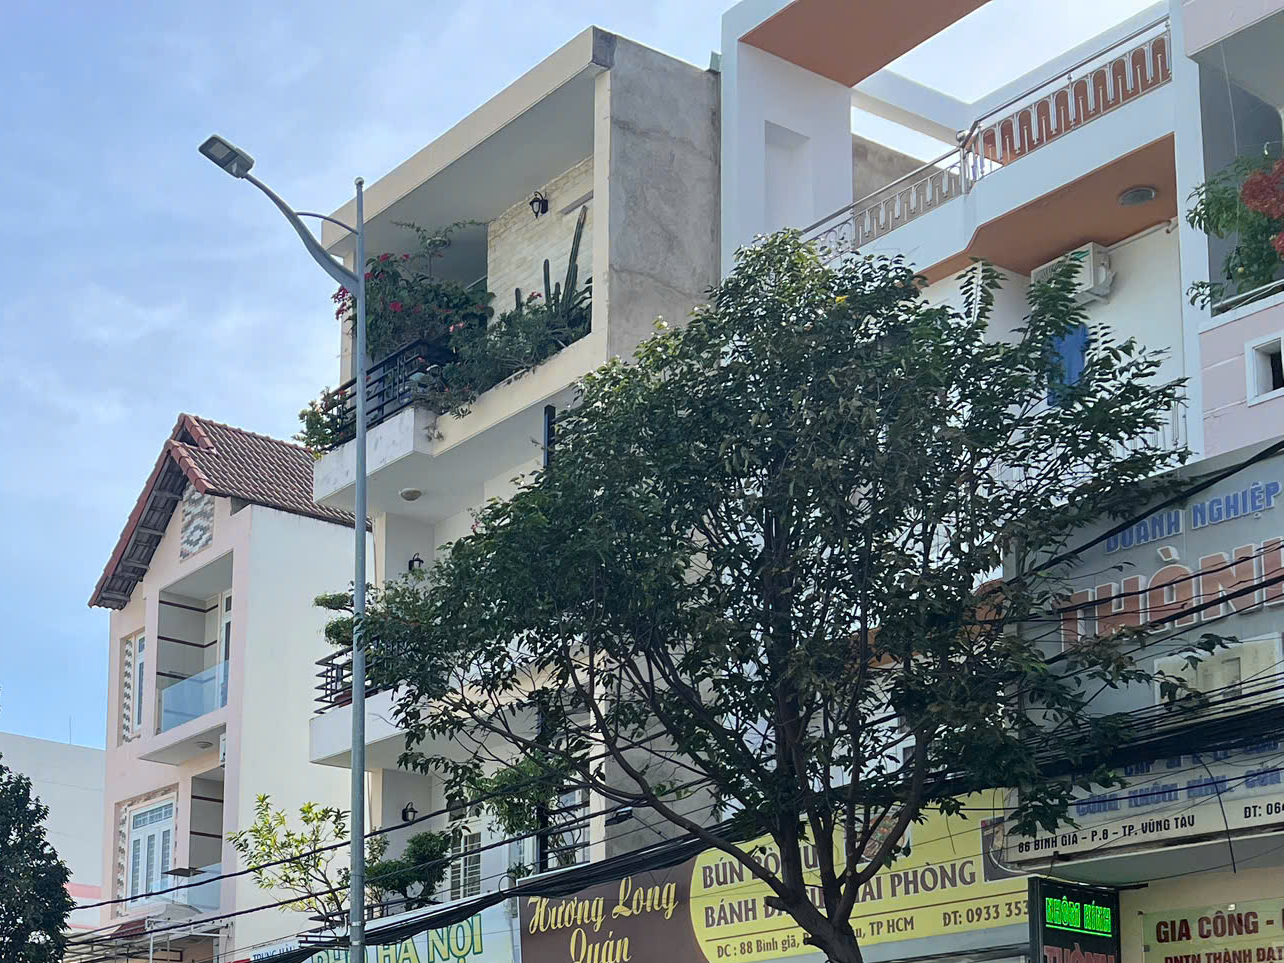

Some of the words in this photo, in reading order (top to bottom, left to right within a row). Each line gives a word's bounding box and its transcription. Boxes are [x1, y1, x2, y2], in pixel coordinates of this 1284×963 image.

[1192, 481, 1280, 529] NGHIỆP
[1018, 842, 1031, 854] 86
[1091, 830, 1109, 843] P.8
[1121, 824, 1138, 838] TP.
[1141, 816, 1171, 834] VŨNG
[1174, 811, 1196, 829] TÀU
[1243, 804, 1262, 820] ĐT:
[702, 856, 745, 890] BÚN
[890, 860, 977, 898] PHÒNG
[527, 895, 606, 935] Hương
[612, 876, 679, 920] Long
[704, 896, 758, 929] BÁNH
[943, 909, 964, 928] ĐT:
[966, 902, 1000, 923] 0933
[717, 943, 732, 959] ĐC
[739, 939, 753, 954] 88
[756, 935, 779, 954] Bình
[781, 933, 801, 952] giã,
[869, 921, 884, 937] TP
[886, 916, 915, 935] HCM
[1156, 919, 1192, 944] GIA
[1198, 910, 1259, 939] CÔNG
